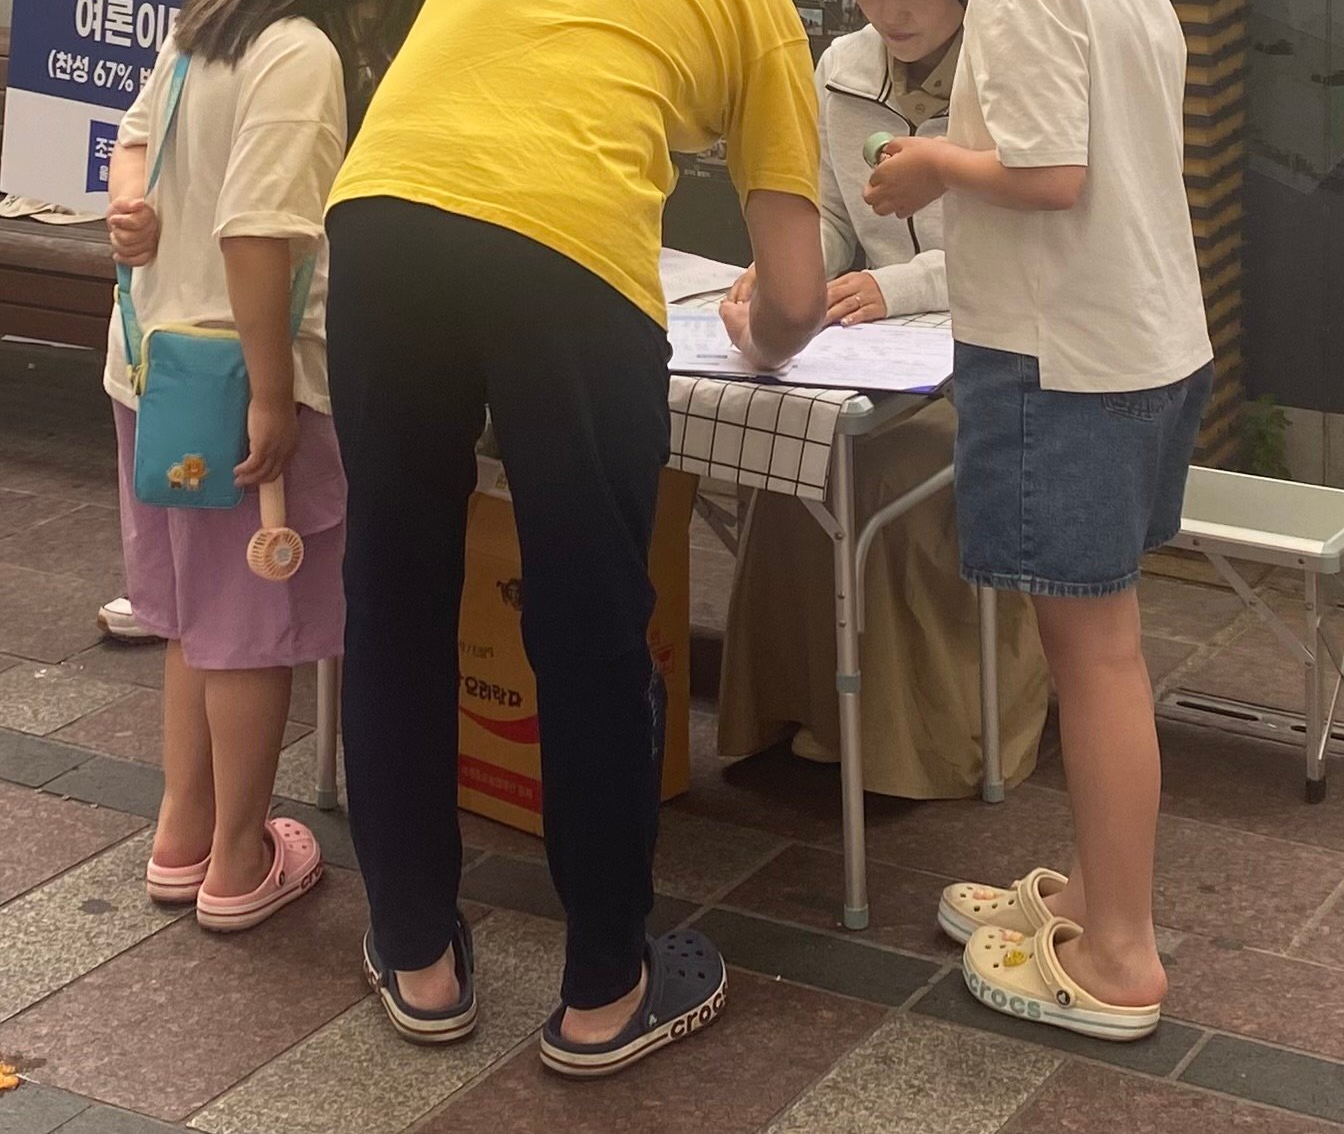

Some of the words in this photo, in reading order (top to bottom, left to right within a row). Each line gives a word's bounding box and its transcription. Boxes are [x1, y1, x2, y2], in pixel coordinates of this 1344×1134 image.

[47, 50, 89, 84] (찬성
[94, 59, 133, 93] 67%
[969, 972, 1041, 1020] crocs
